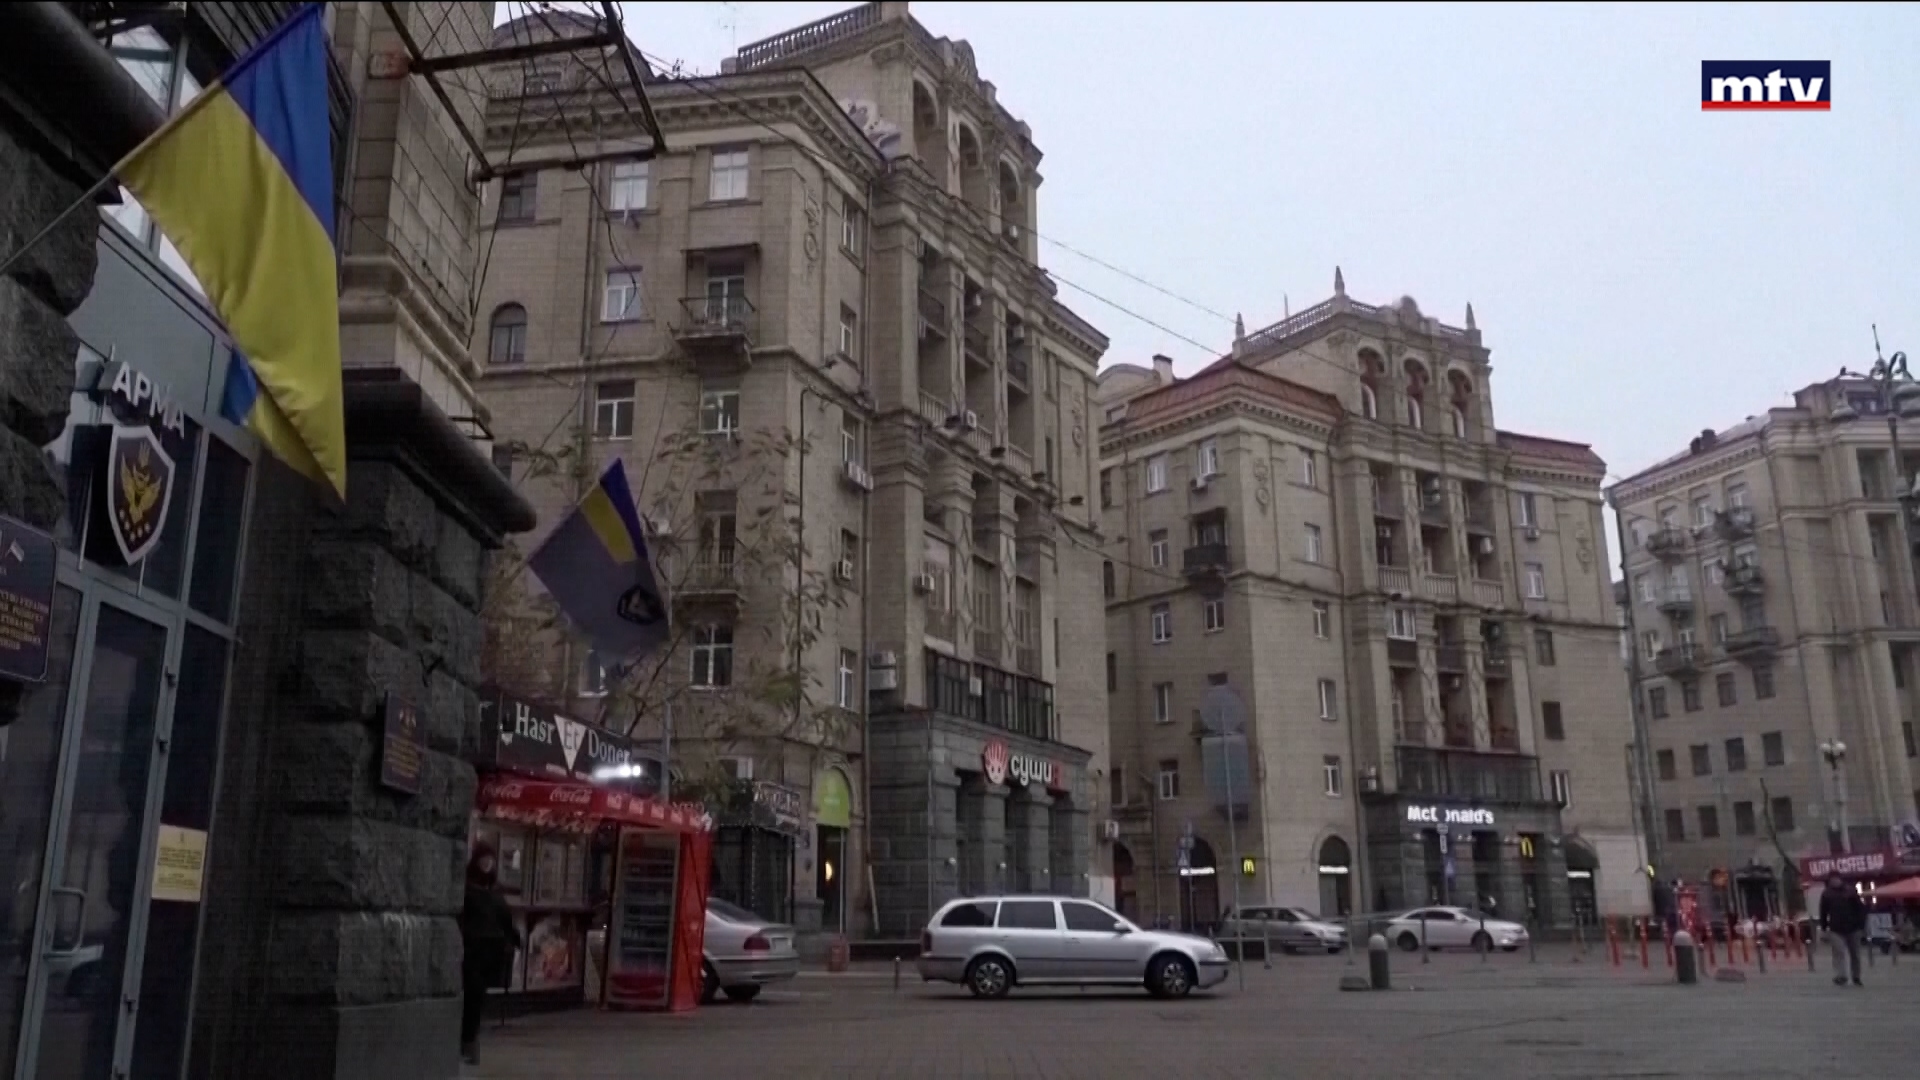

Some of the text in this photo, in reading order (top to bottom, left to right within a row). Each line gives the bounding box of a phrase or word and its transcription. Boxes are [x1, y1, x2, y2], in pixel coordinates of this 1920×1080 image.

[112, 361, 185, 440] АРМА
[515, 701, 556, 745] Hasr
[588, 729, 631, 764] Doner
